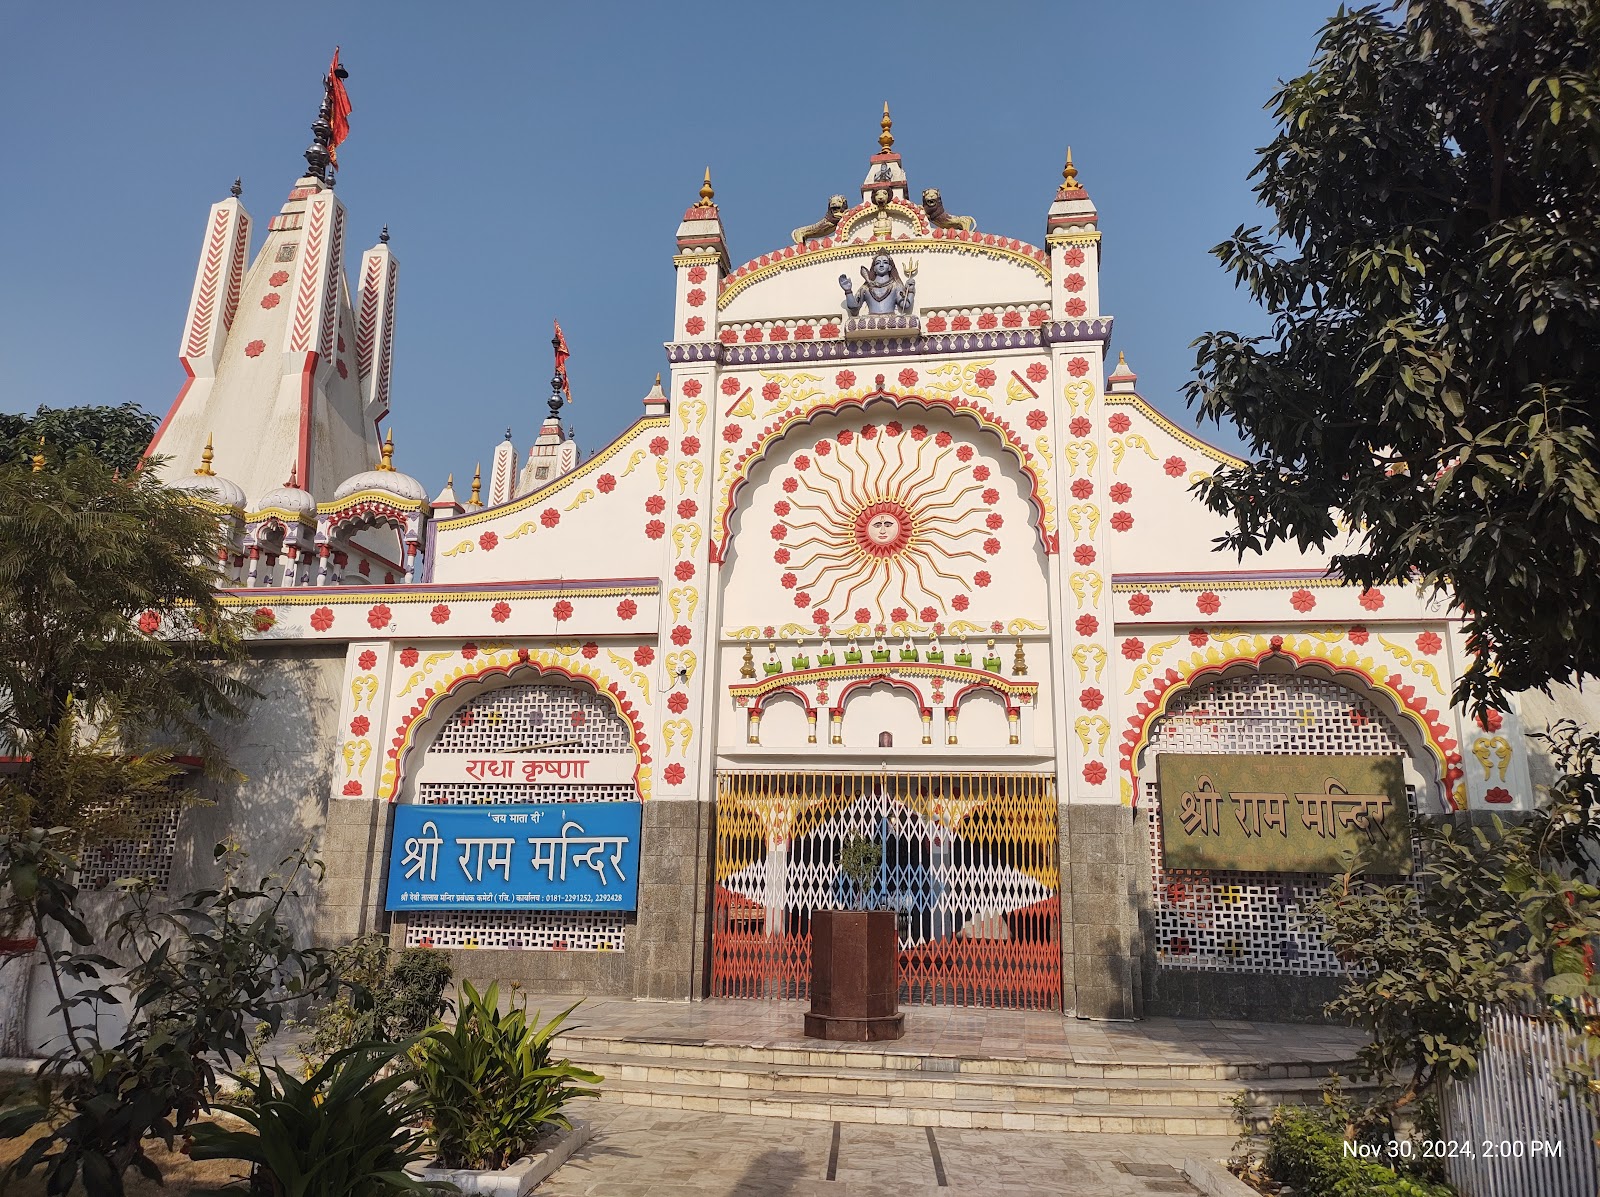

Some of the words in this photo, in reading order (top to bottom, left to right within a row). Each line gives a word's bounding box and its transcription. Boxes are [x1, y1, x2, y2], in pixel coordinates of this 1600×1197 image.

[465, 760, 515, 781] राधा
[521, 760, 590, 783] कृष्णा
[509, 813, 529, 824] माता
[1178, 774, 1224, 836] श्री
[1228, 791, 1289, 838] राम
[1294, 776, 1393, 845] मन्दिर
[401, 821, 443, 882] श्री
[455, 837, 516, 882] राम
[527, 821, 630, 886] मन्दिर
[400, 891, 409, 902] श्री
[595, 894, 623, 902] 2292428
